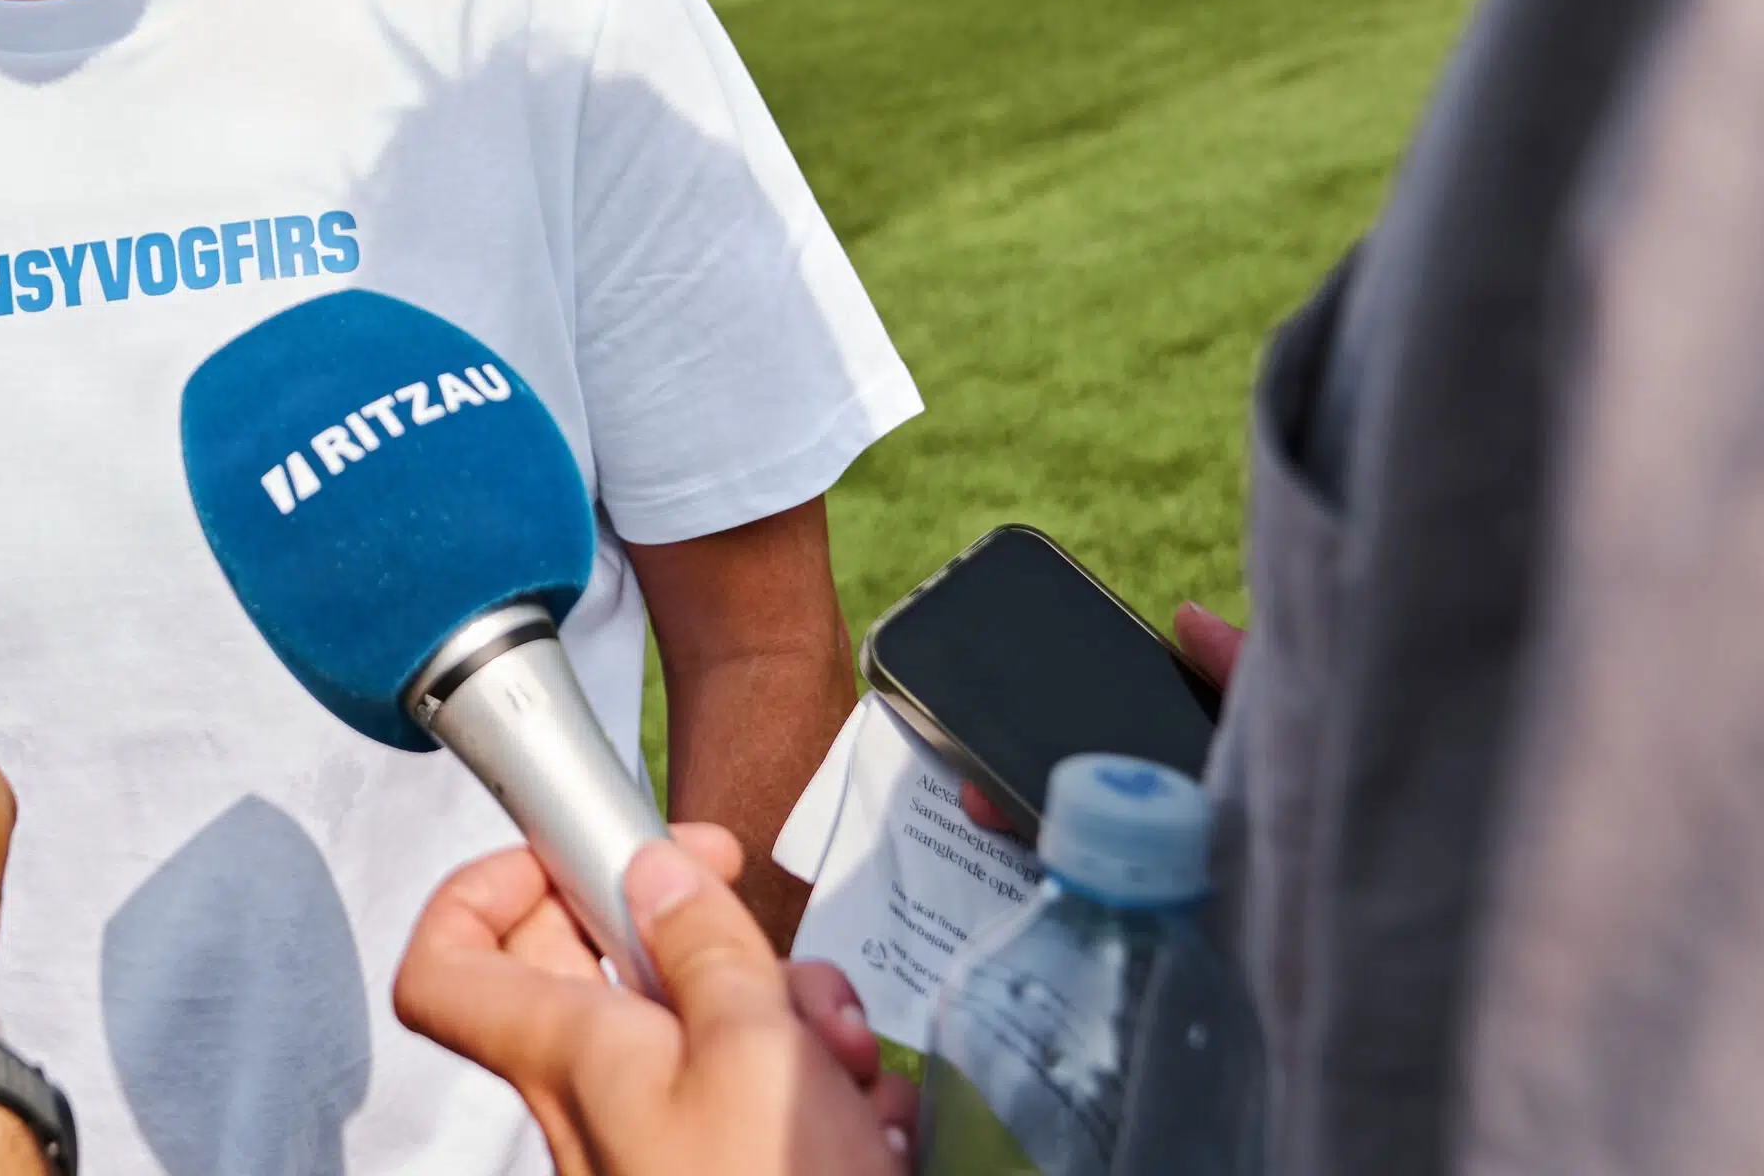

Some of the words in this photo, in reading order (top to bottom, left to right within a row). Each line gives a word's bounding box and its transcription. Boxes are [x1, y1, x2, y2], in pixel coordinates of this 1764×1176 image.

[310, 363, 512, 475] RITZAU
[903, 823, 987, 881] manglende
[909, 796, 1013, 869] Samarbejdets
